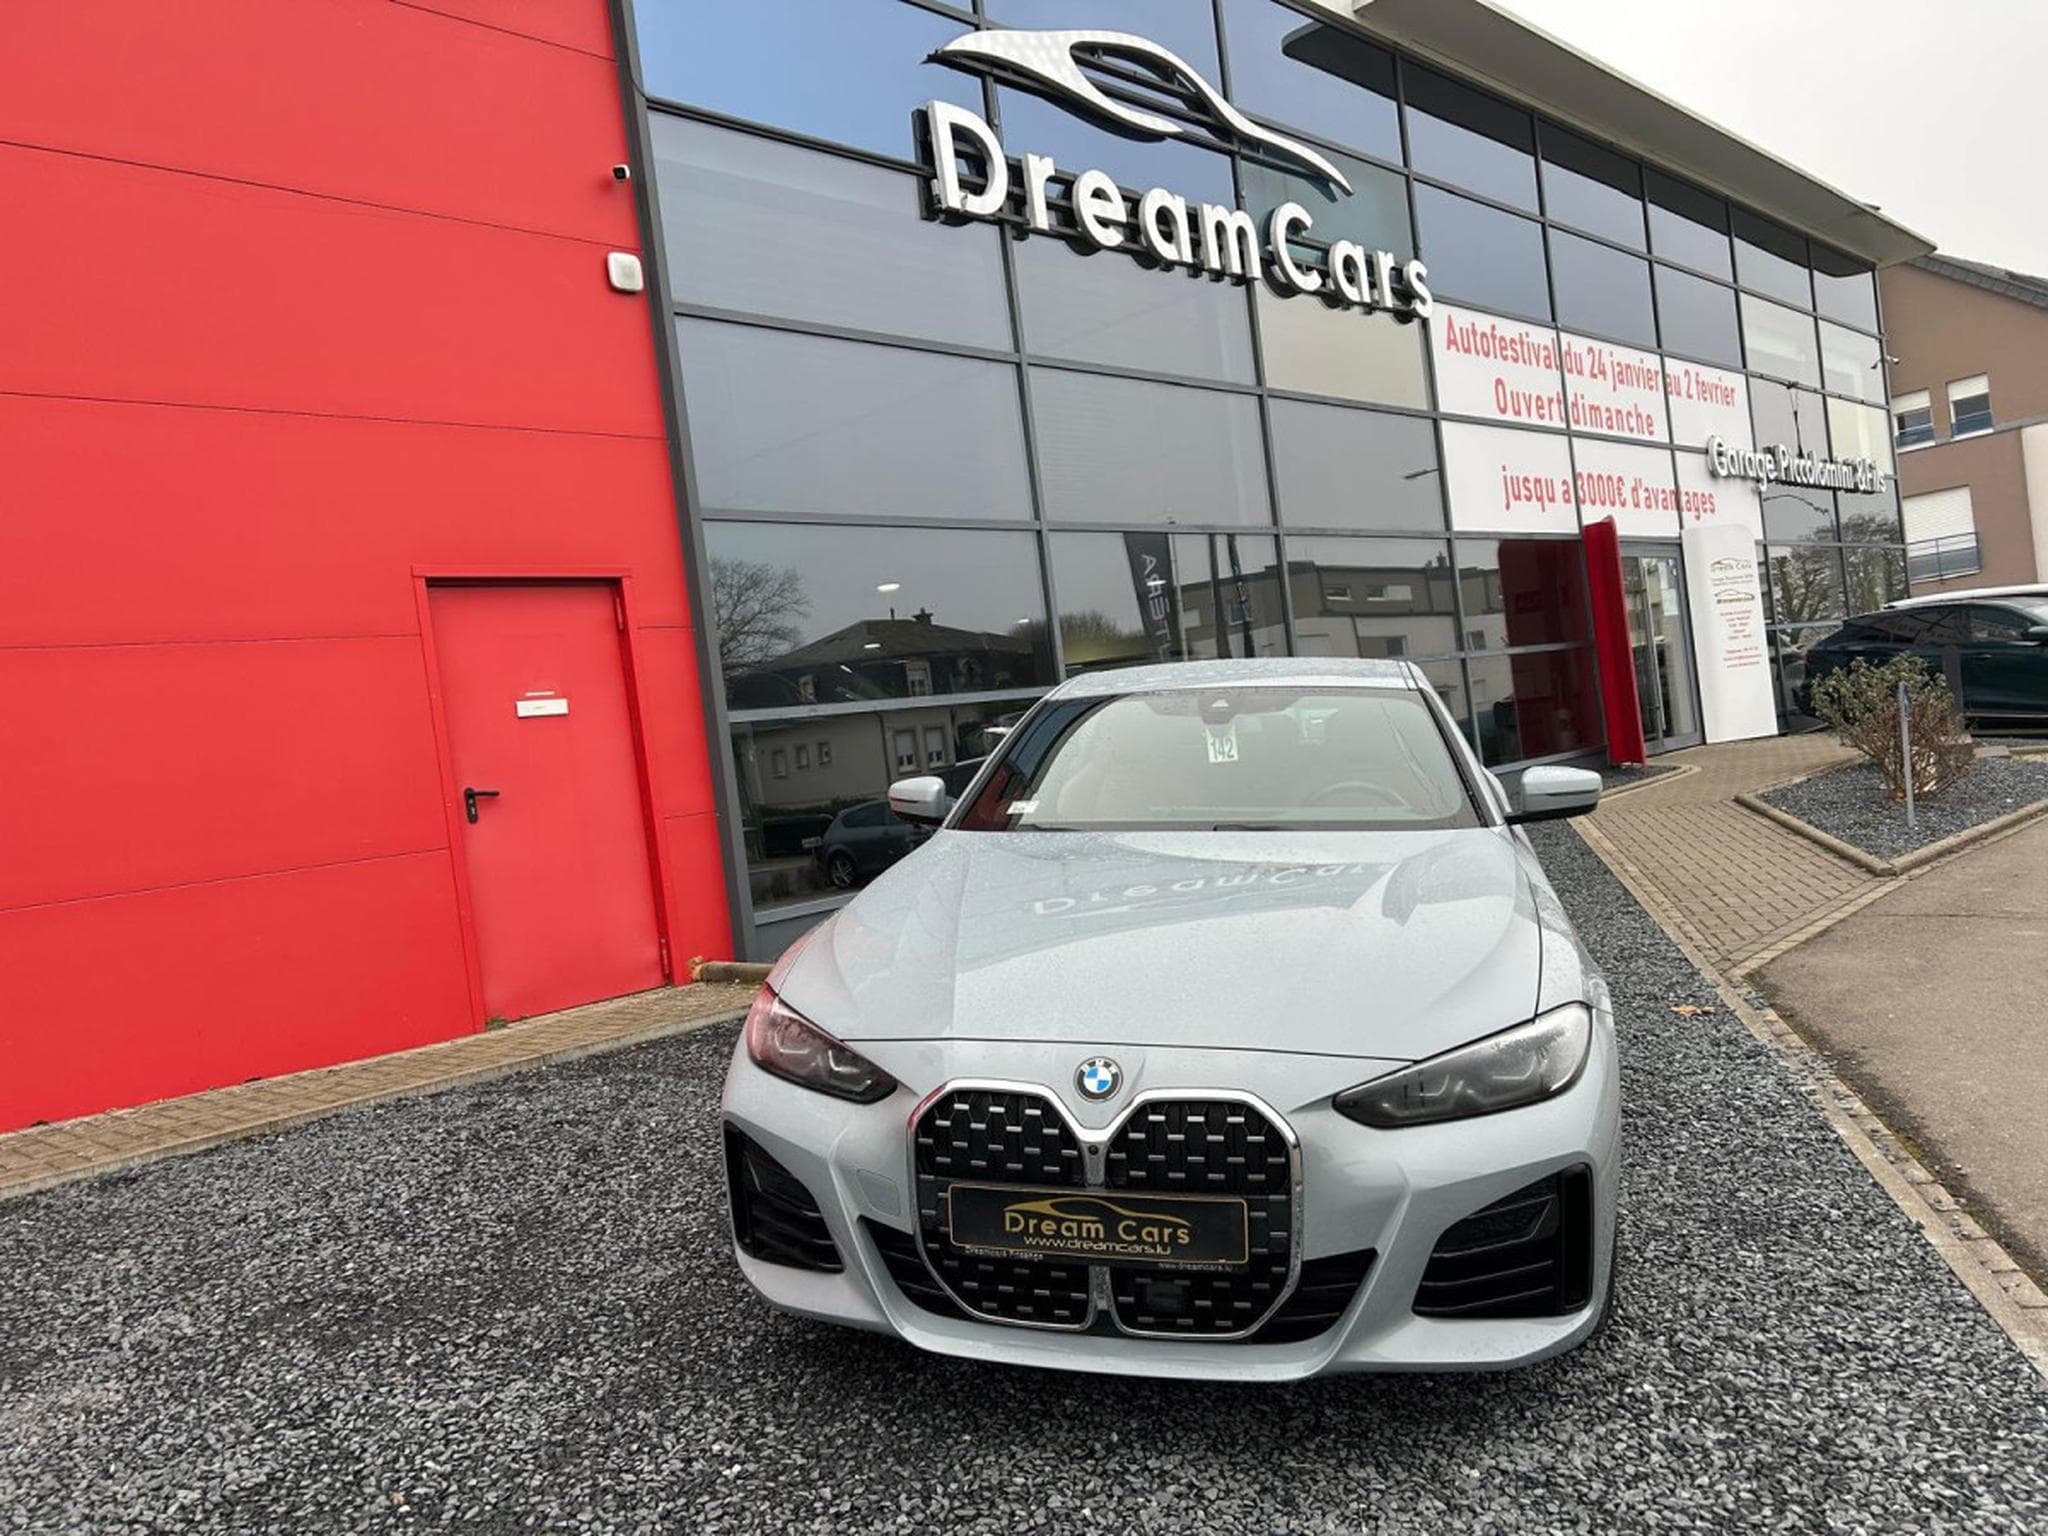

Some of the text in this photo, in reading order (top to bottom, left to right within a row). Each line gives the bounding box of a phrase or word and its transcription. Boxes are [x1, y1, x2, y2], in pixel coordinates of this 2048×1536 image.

[1446, 314, 1559, 371] Autofestival
[1564, 341, 1584, 376] du
[1587, 346, 1607, 381] 24
[1610, 351, 1660, 392] janvier
[1665, 373, 1682, 397] au
[1684, 368, 1693, 399] 2
[1494, 377, 1654, 436] Ouvert dimanche
[1711, 436, 1777, 491] Garage
[1779, 444, 1854, 489] Piccolomini
[1502, 464, 1556, 513] jusqu
[1561, 479, 1572, 504] a
[1576, 471, 1627, 508] 3000€
[1210, 737, 1235, 760] 142
[1005, 1211, 1190, 1244] Dream Cars
[1024, 1236, 1171, 1255] www.dreamcars.lu
